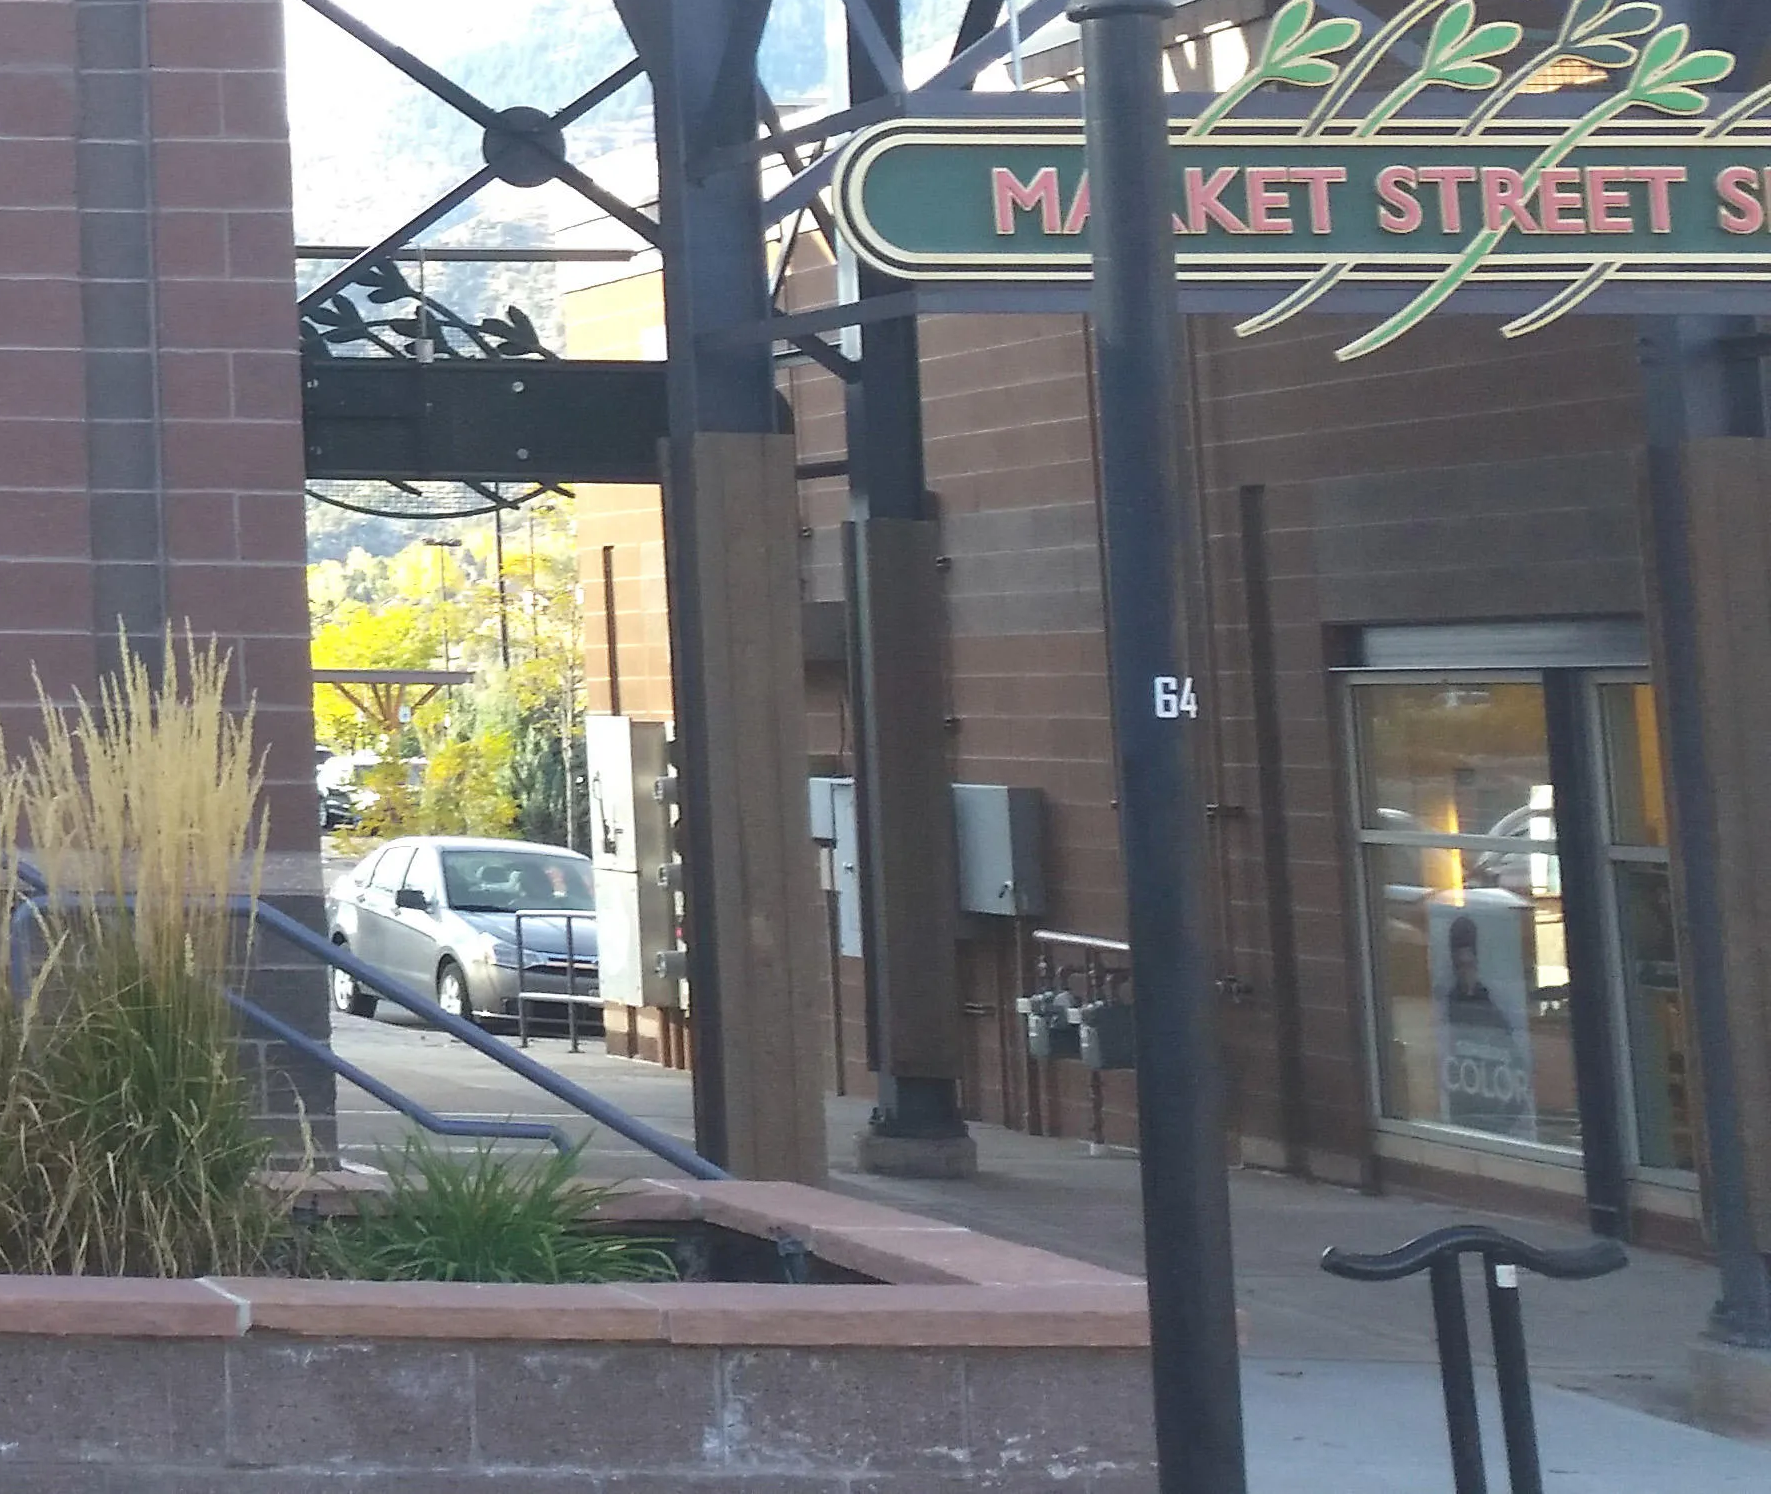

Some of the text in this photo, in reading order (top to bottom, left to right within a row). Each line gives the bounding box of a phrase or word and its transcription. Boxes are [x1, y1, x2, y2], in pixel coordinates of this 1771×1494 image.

[992, 165, 1771, 235] MKET STREET S
[1154, 676, 1198, 719] 64
